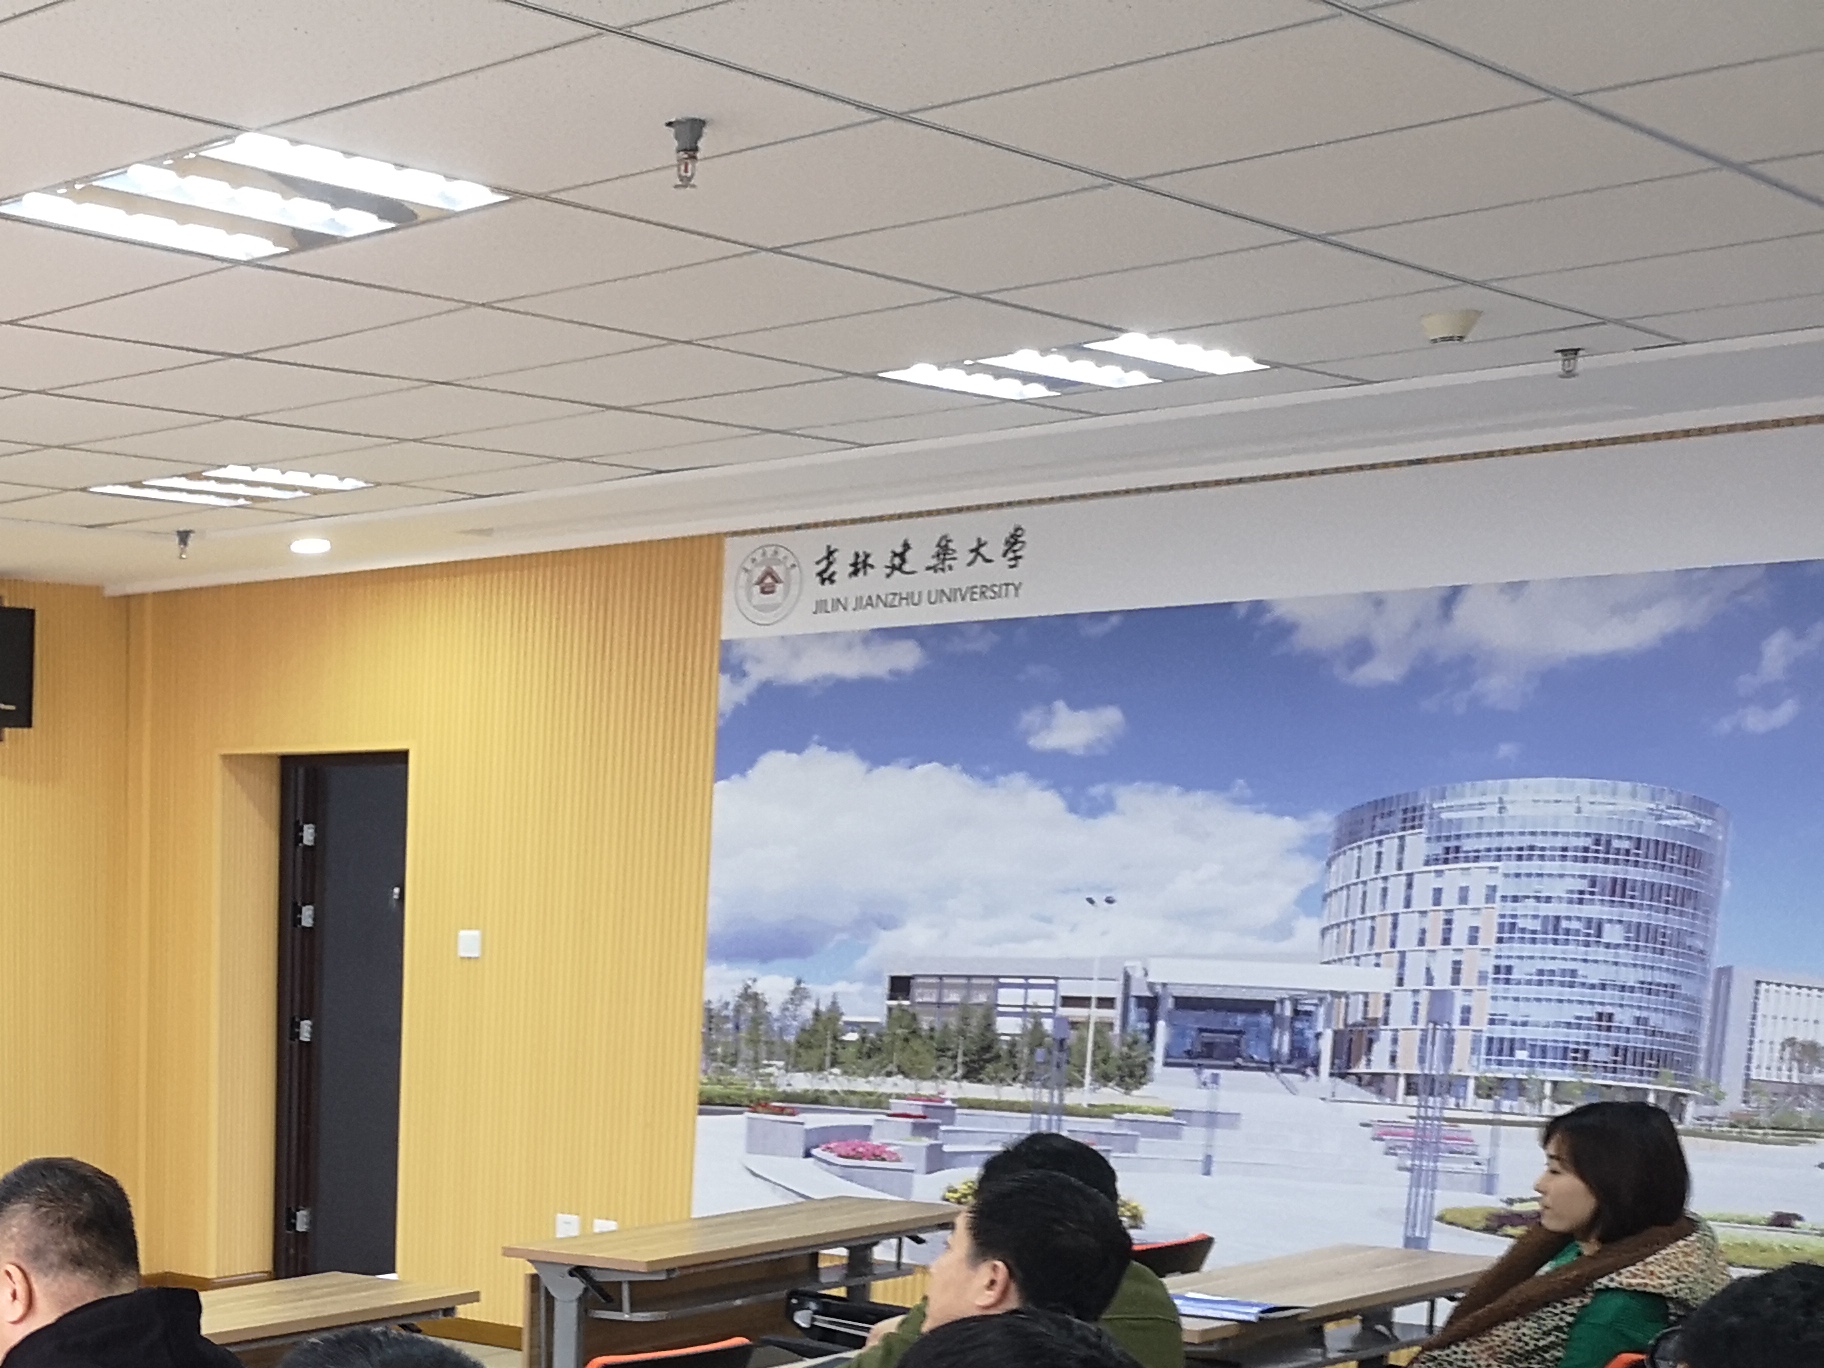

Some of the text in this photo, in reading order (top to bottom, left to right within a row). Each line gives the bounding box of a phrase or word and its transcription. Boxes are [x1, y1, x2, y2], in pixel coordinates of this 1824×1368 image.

[812, 581, 1023, 614] JILIN JIANZHU UNIVERSITY
